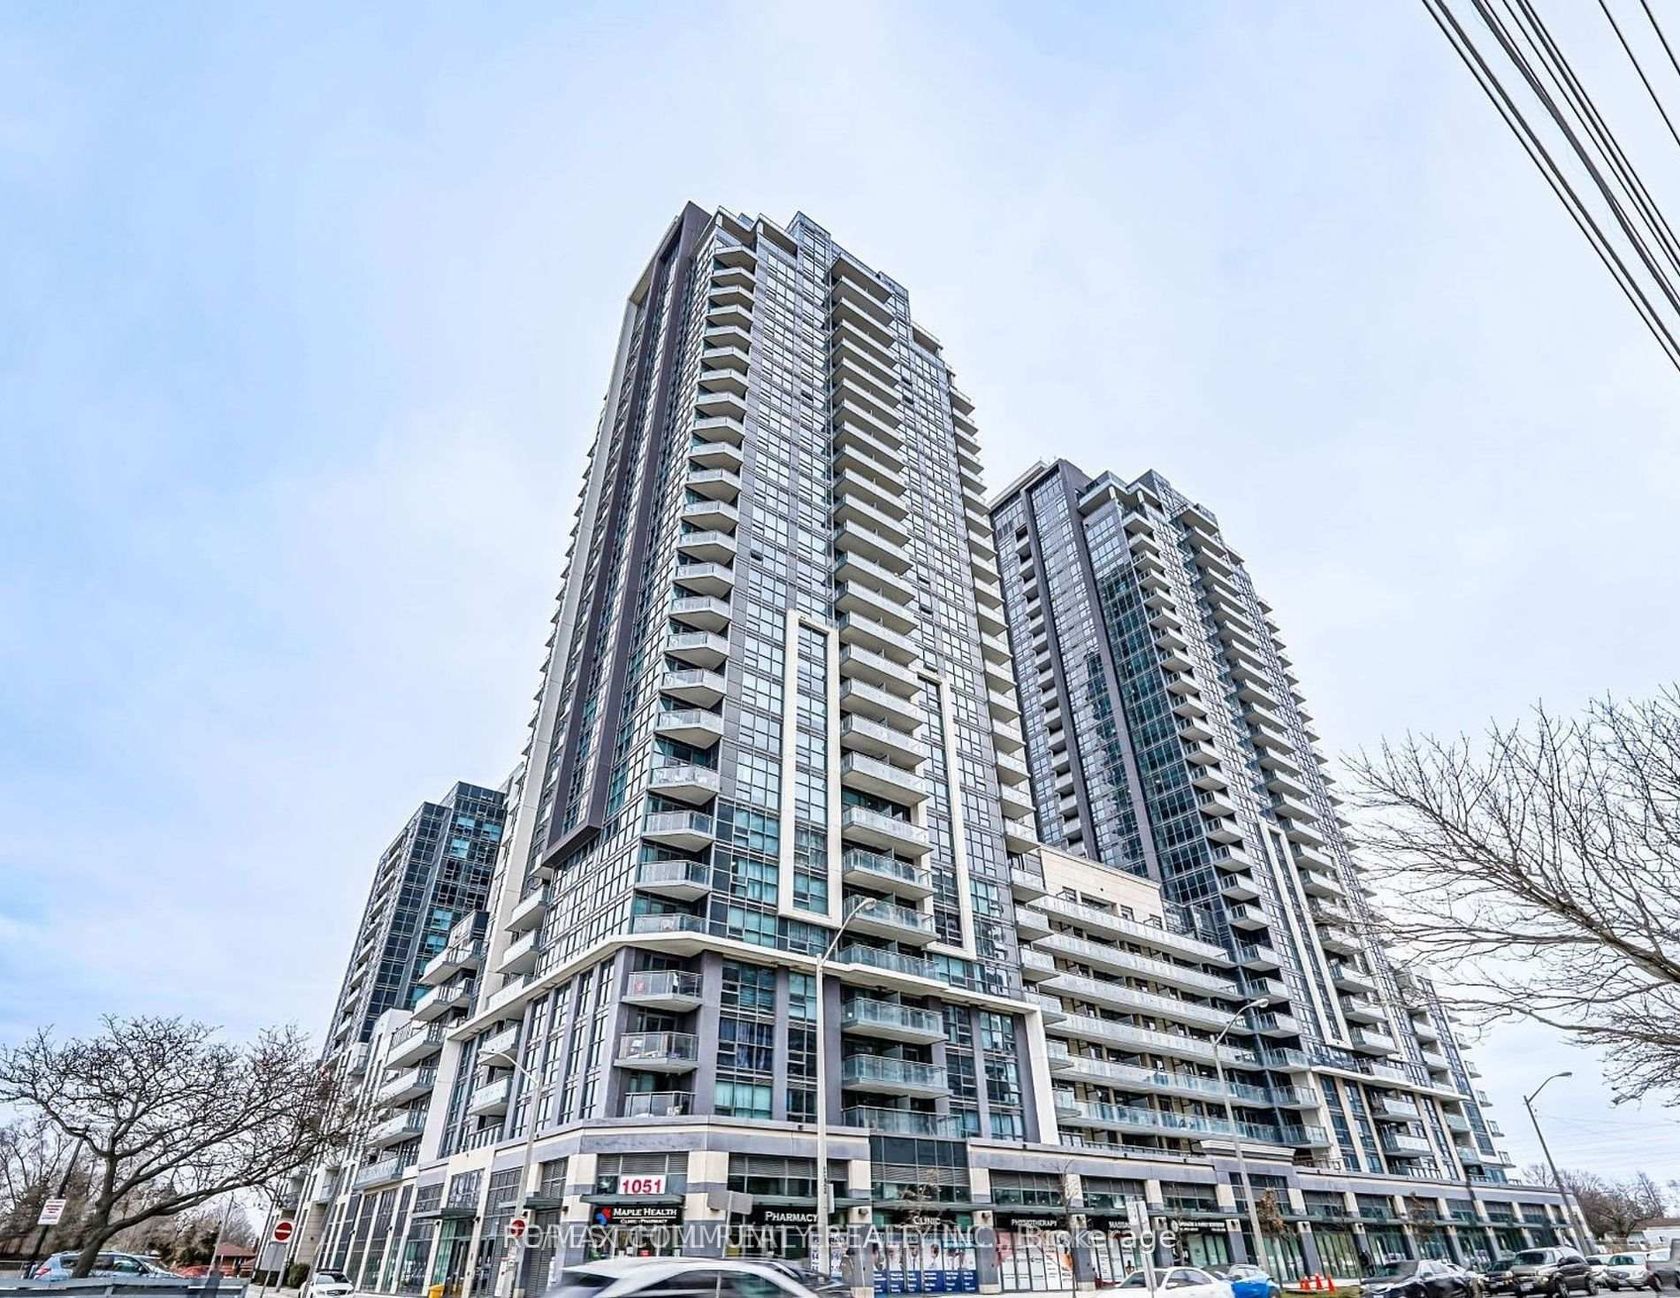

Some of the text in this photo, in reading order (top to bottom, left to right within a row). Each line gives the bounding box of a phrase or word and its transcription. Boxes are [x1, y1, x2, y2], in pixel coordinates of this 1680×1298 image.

[622, 1179, 662, 1194] 1051
[613, 1207, 677, 1216] MAPLE HEALTH
[765, 1211, 818, 1222] PHARMACY
[913, 1215, 941, 1225] CLINIC
